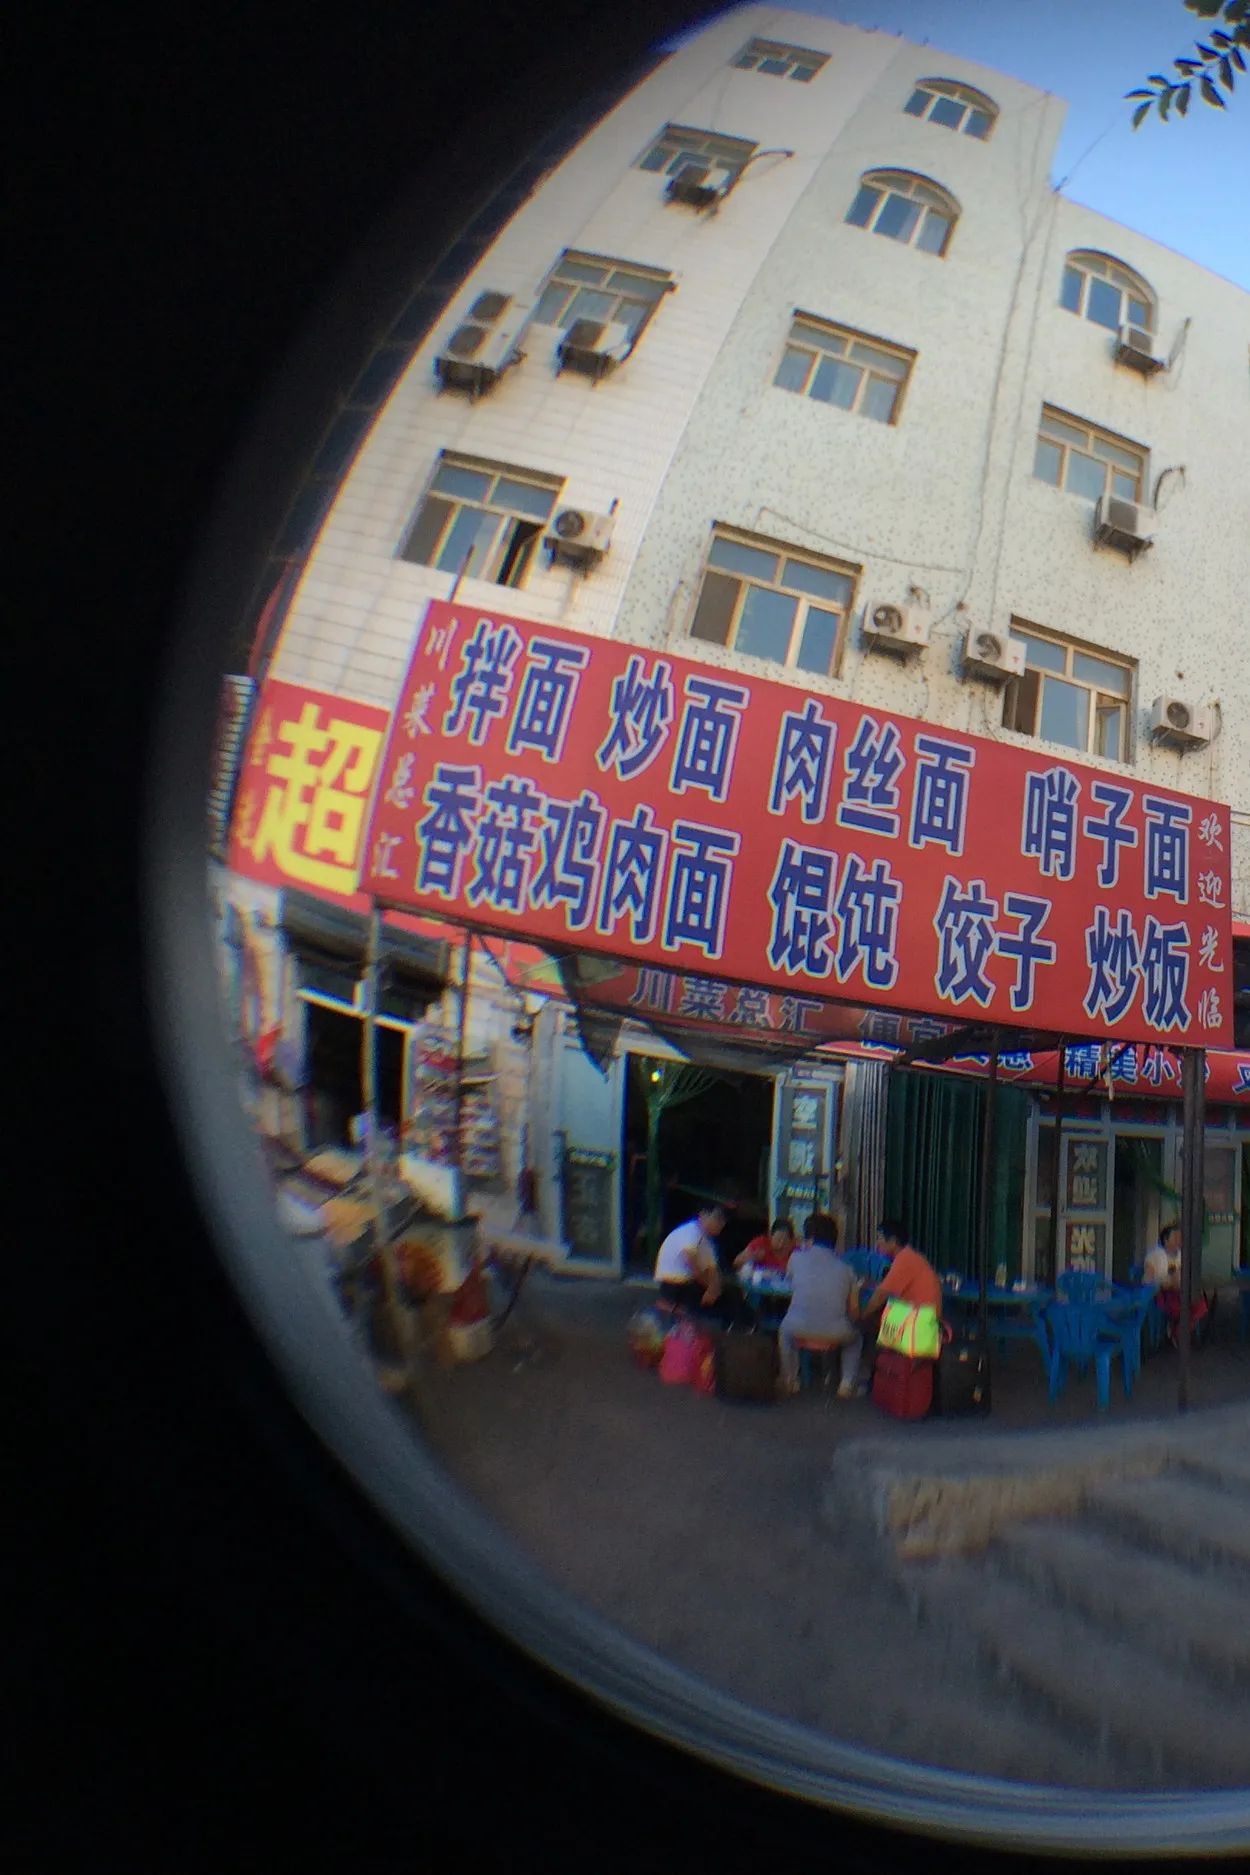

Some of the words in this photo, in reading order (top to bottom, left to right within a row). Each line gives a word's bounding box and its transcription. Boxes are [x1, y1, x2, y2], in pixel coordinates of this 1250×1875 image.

[253, 701, 385, 896] 超
[371, 616, 459, 879] 川菜总汇
[441, 616, 590, 763] 拌面
[595, 655, 750, 803] 炒面
[767, 698, 977, 857] 肉丝面
[1020, 766, 1193, 905] 哨子面
[414, 762, 742, 960] 香菇鸡肉面
[767, 838, 903, 990] 馄饨
[934, 874, 1057, 1012] 饺子
[1083, 905, 1193, 1034] 炒饭
[1197, 812, 1226, 1030] 欢迎光临
